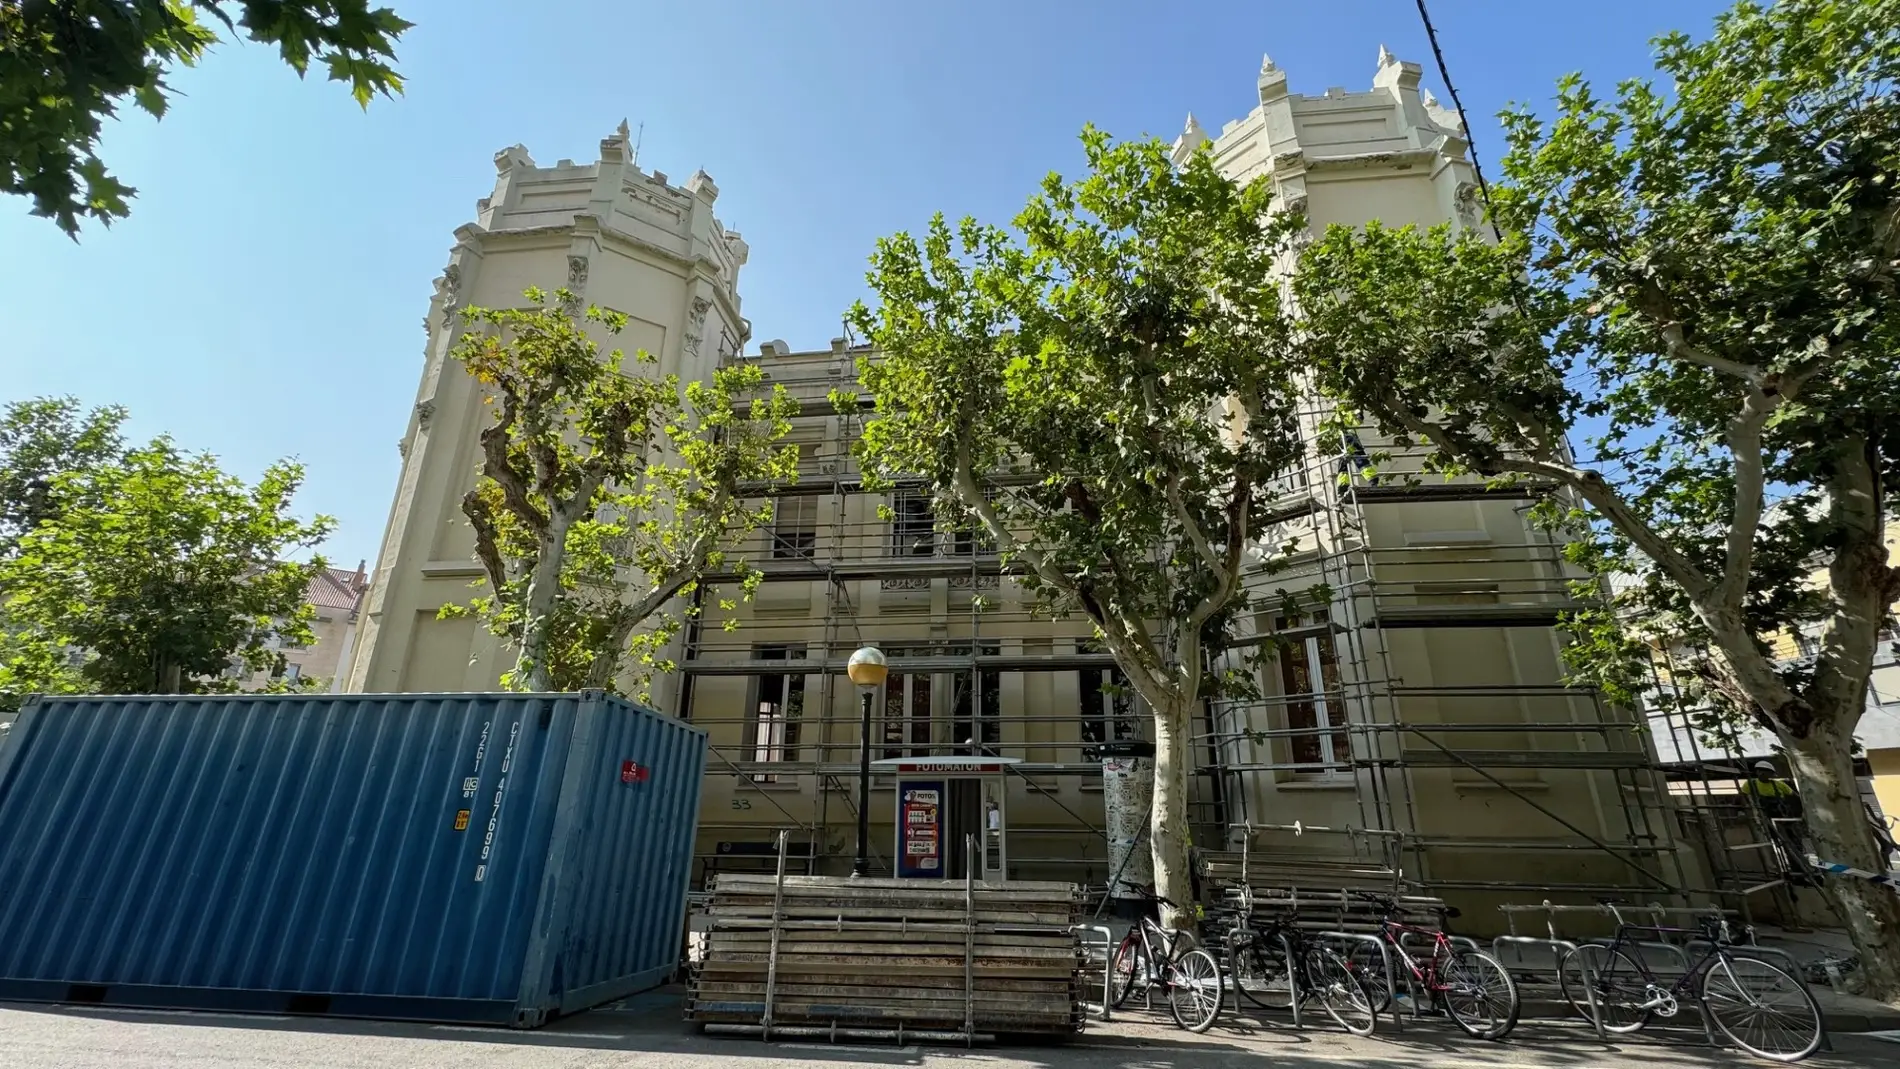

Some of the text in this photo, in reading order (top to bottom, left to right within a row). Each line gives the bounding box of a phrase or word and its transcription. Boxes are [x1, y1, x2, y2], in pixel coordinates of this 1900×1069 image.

[474, 721, 490, 772] 22G1
[502, 721, 519, 773] CTXU
[916, 763, 981, 771] FOTOMATON
[481, 777, 505, 860] 407699
[731, 799, 752, 810] 33
